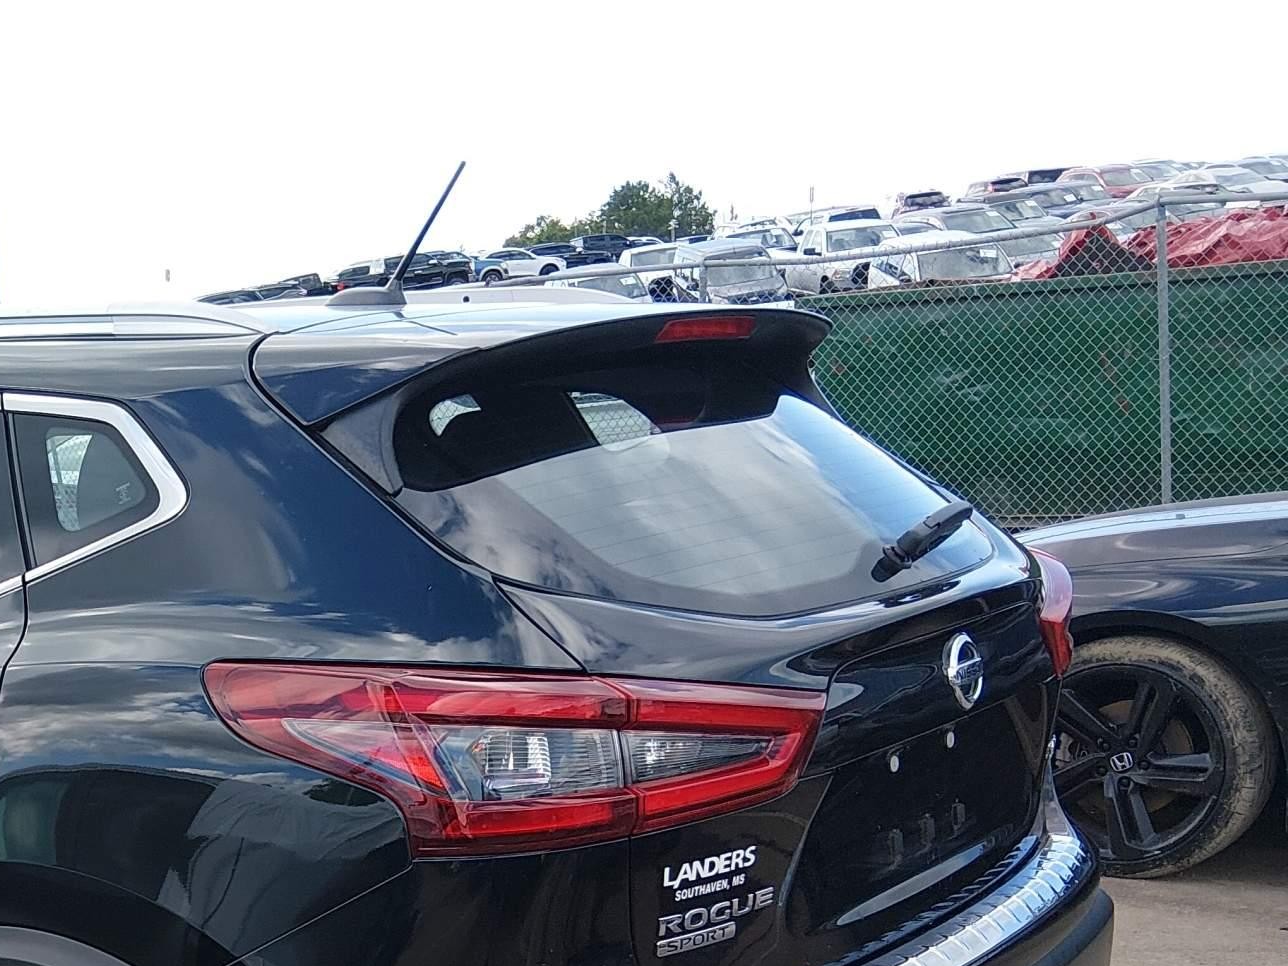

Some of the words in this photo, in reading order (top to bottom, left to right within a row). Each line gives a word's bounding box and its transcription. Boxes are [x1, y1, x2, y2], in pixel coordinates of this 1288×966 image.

[663, 846, 756, 888] LANDERS
[675, 879, 730, 901] SOUTHAVEN,
[732, 874, 745, 887] MS
[659, 887, 774, 936] ROGUE
[667, 927, 729, 951] SPORT
